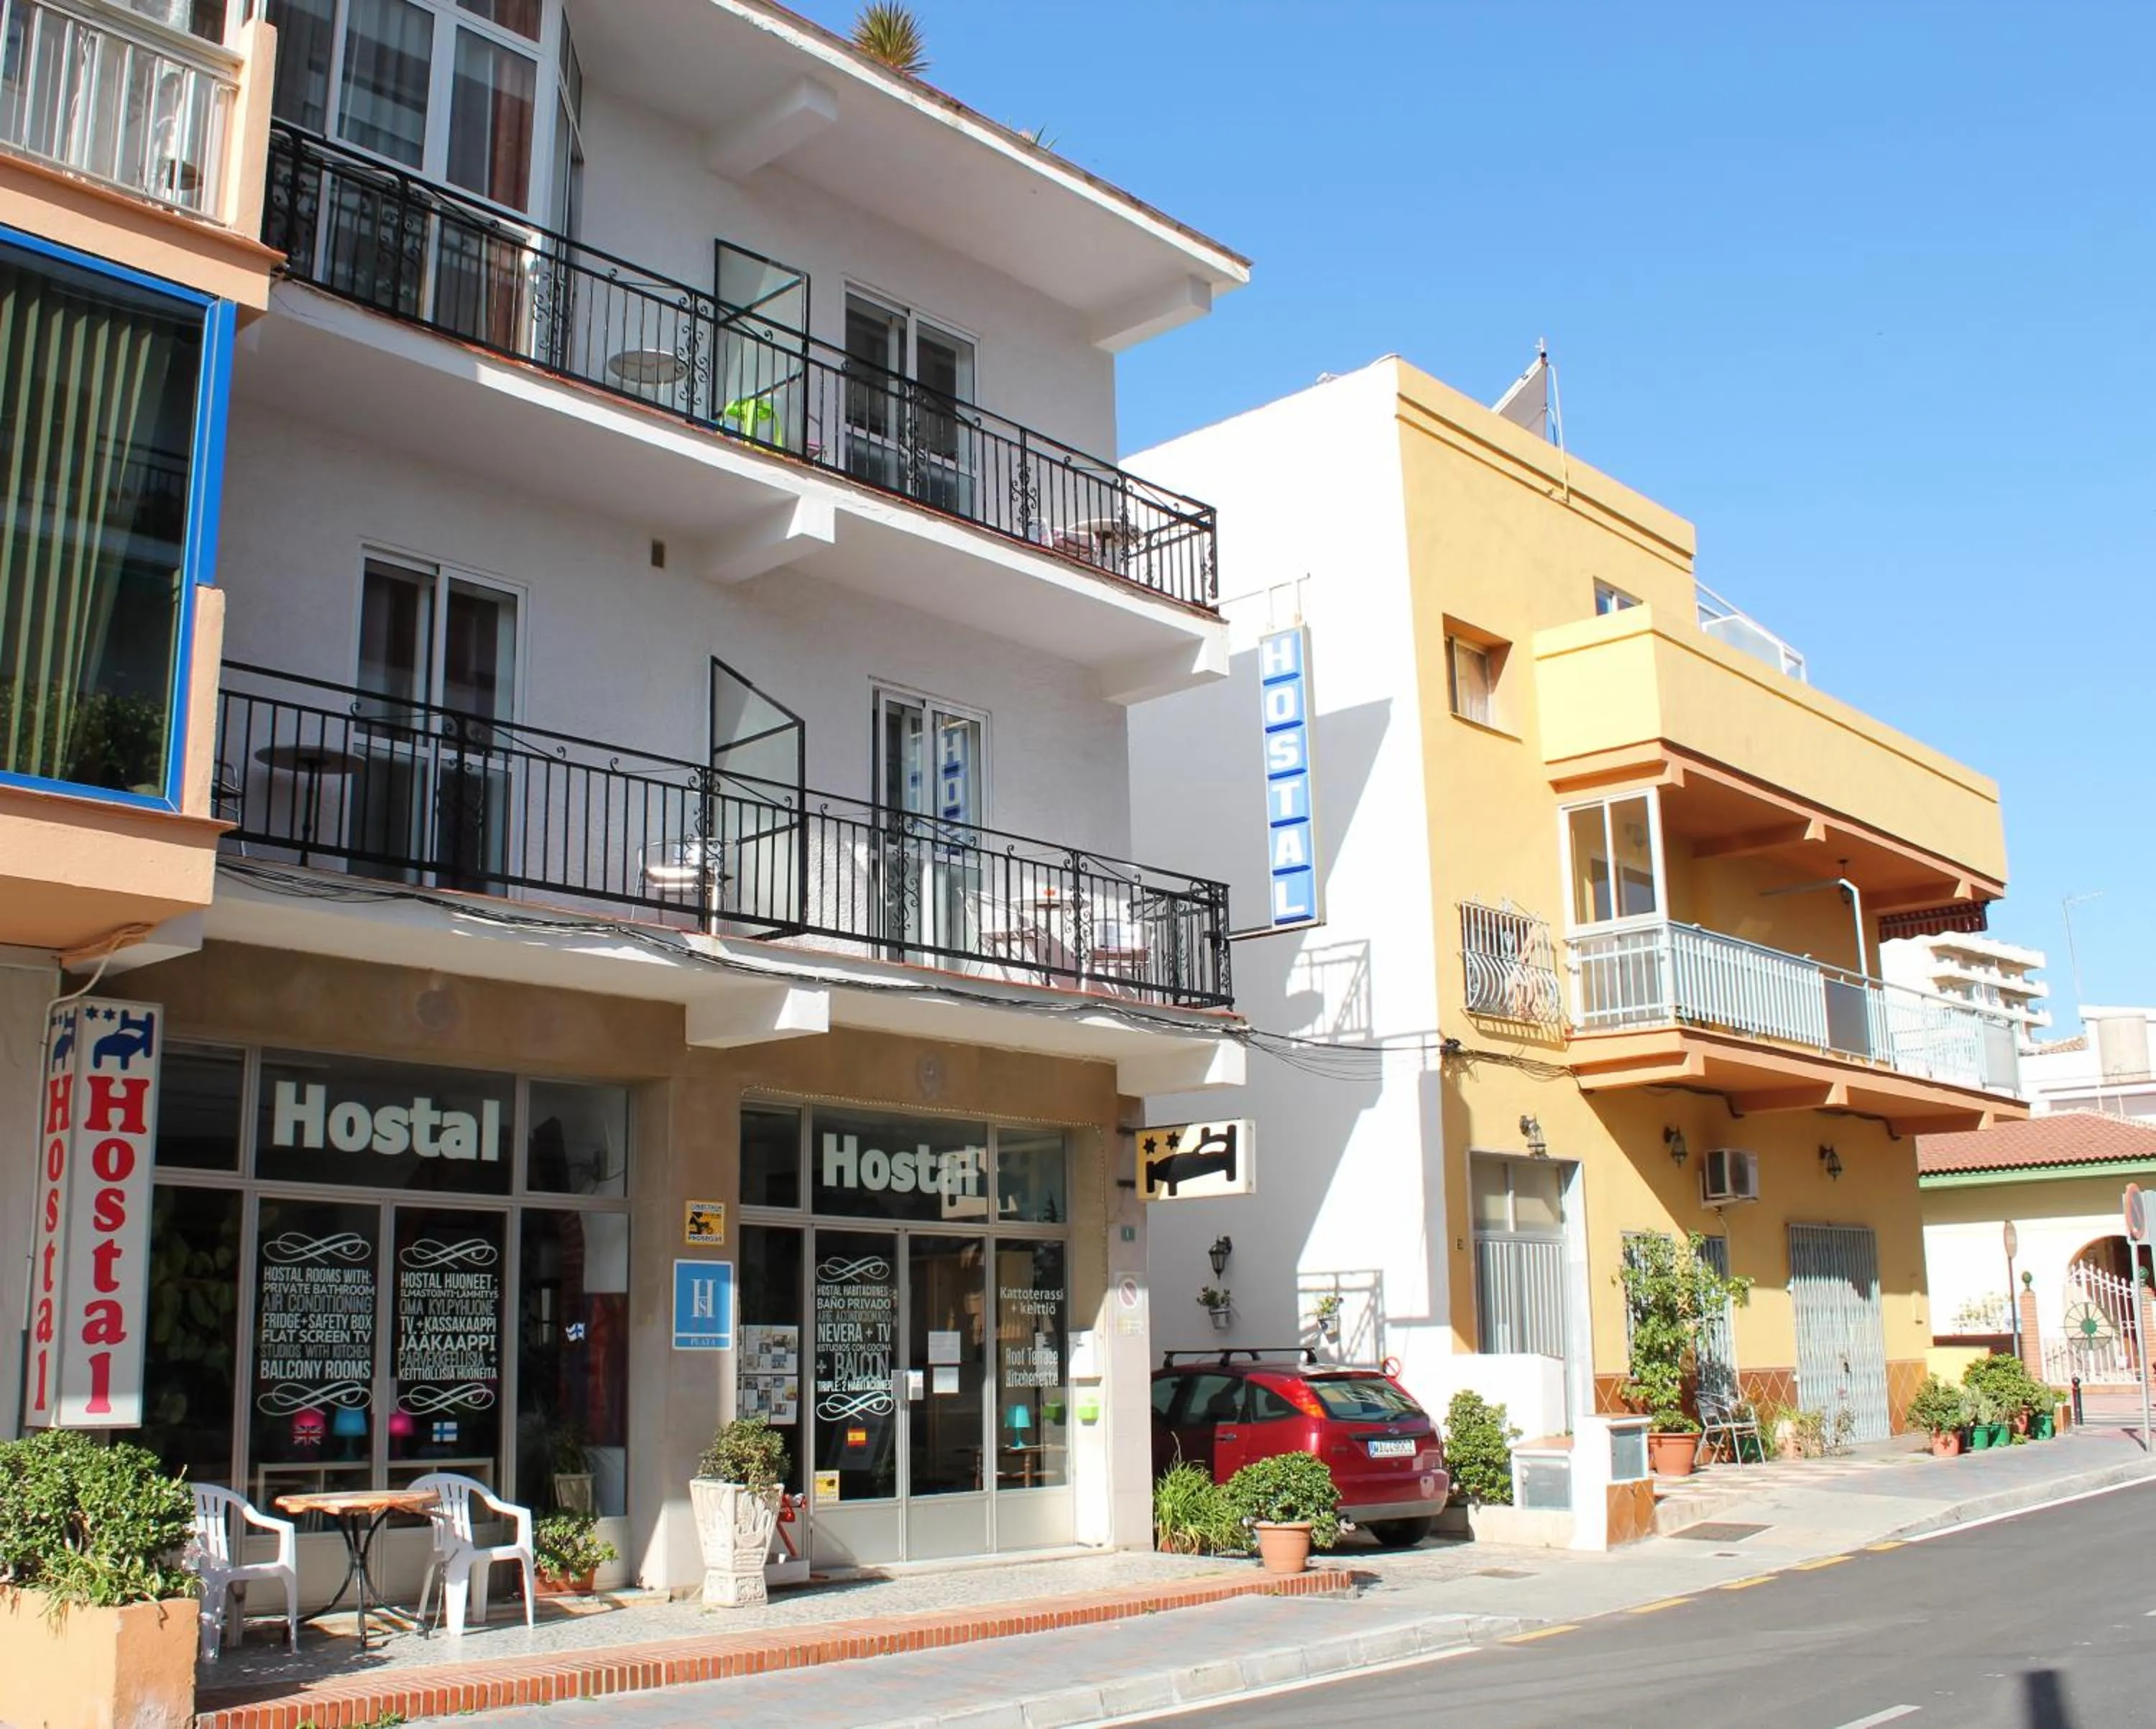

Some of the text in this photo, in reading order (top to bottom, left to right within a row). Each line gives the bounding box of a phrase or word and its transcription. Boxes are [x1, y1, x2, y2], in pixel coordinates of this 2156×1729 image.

[1263, 637, 1306, 916] HOSTAL
[273, 1081, 500, 1161] Hostal
[823, 1133, 977, 1196] Hostal
[34, 1074, 73, 1410] Hostal
[82, 1076, 150, 1413] Hostal
[264, 1266, 303, 1281] HOSTAL
[305, 1268, 341, 1283] ROOMS
[400, 1272, 442, 1288] HOSTAL
[263, 1283, 375, 1296] PRIVATE BATHROOM
[817, 1285, 841, 1296] HOSTAL
[1000, 1286, 1064, 1300] Kattoterassi
[262, 1295, 374, 1313] AIR CONDITIONING
[399, 1299, 495, 1316] OMA KYLPYHUONE
[817, 1296, 891, 1310] BAÑO PRIVADO
[351, 1314, 373, 1330] BOX
[400, 1317, 415, 1334] TV
[262, 1329, 372, 1343] FLAT SCREEN TV
[818, 1323, 862, 1342] NEVERA
[877, 1323, 891, 1342] TV
[260, 1345, 371, 1359] STUDIOS WITH KITCHEN
[817, 1343, 892, 1352] ESTUDIOS CON COCINA
[261, 1360, 371, 1380] BALCONY ROOMS
